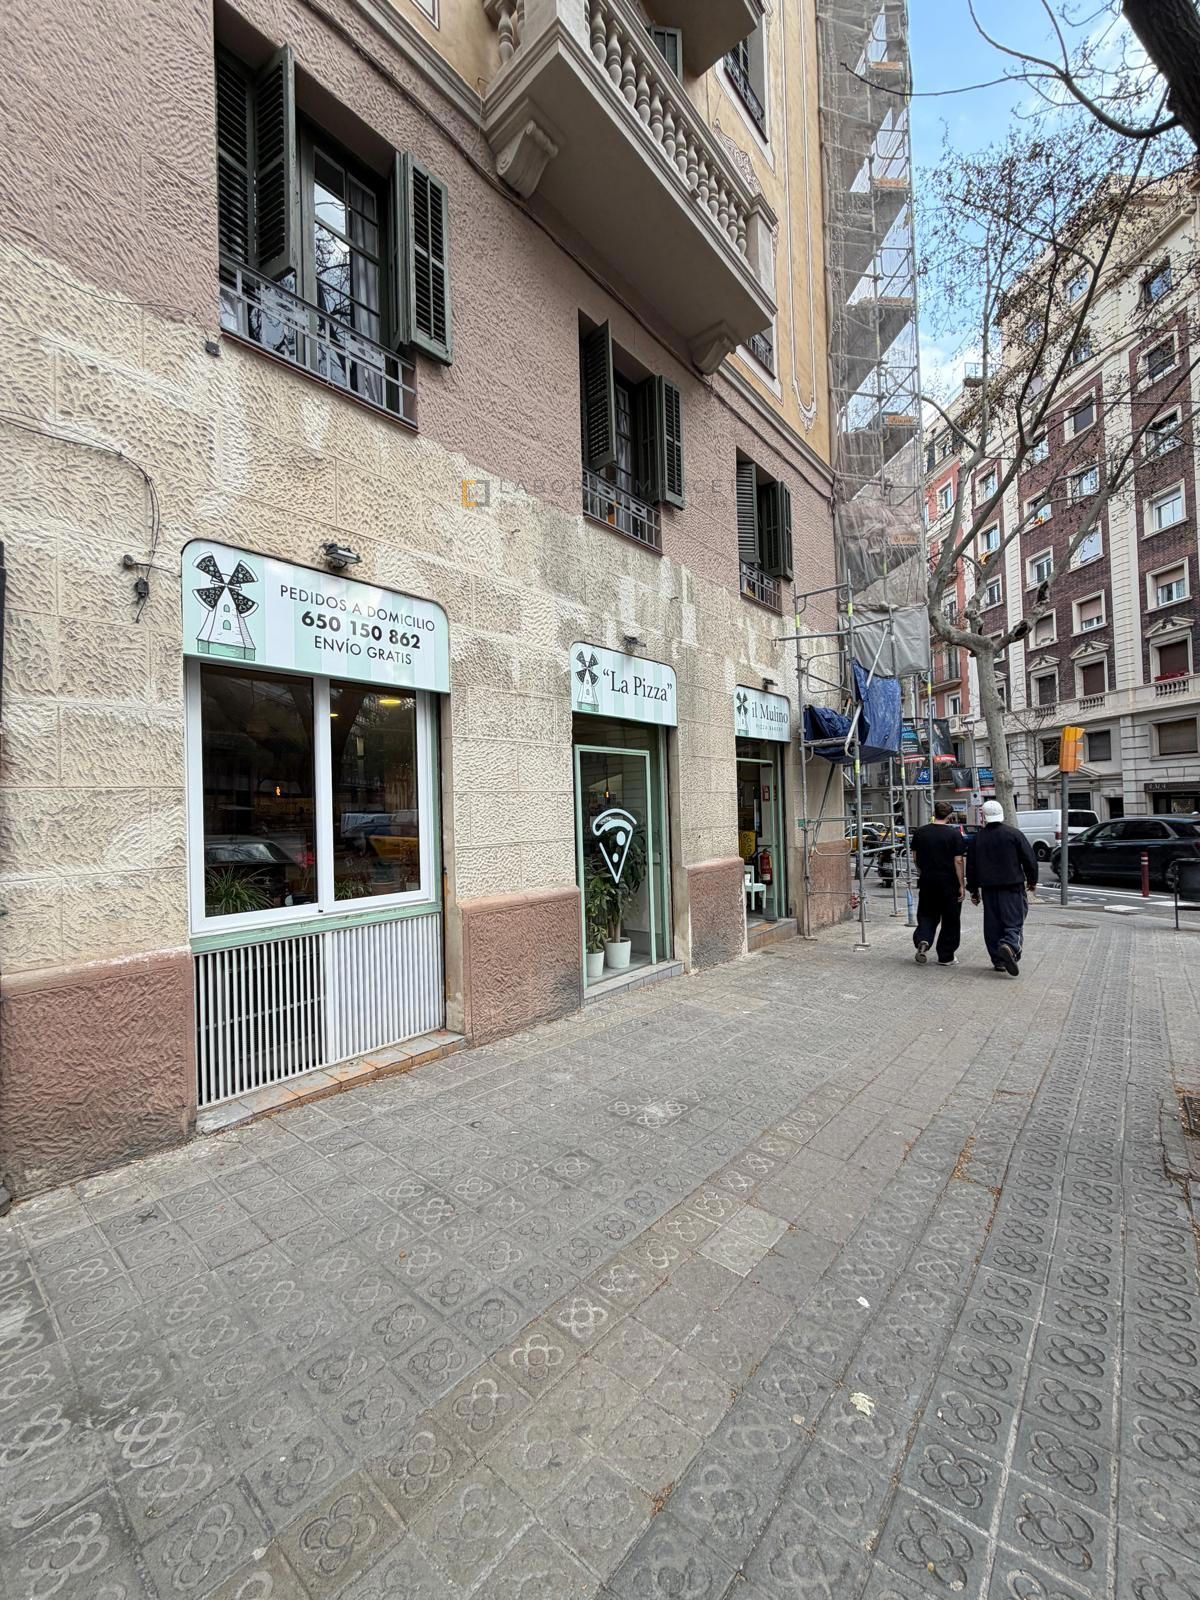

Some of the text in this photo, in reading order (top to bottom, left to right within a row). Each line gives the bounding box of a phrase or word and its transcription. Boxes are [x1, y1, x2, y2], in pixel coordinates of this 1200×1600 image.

[280, 585, 434, 632] PEDIDOS A DOMICILIO
[301, 611, 421, 649] 650 150 862
[314, 635, 412, 664] ENVÍO GRATIS
[751, 701, 788, 724] il Mulino
